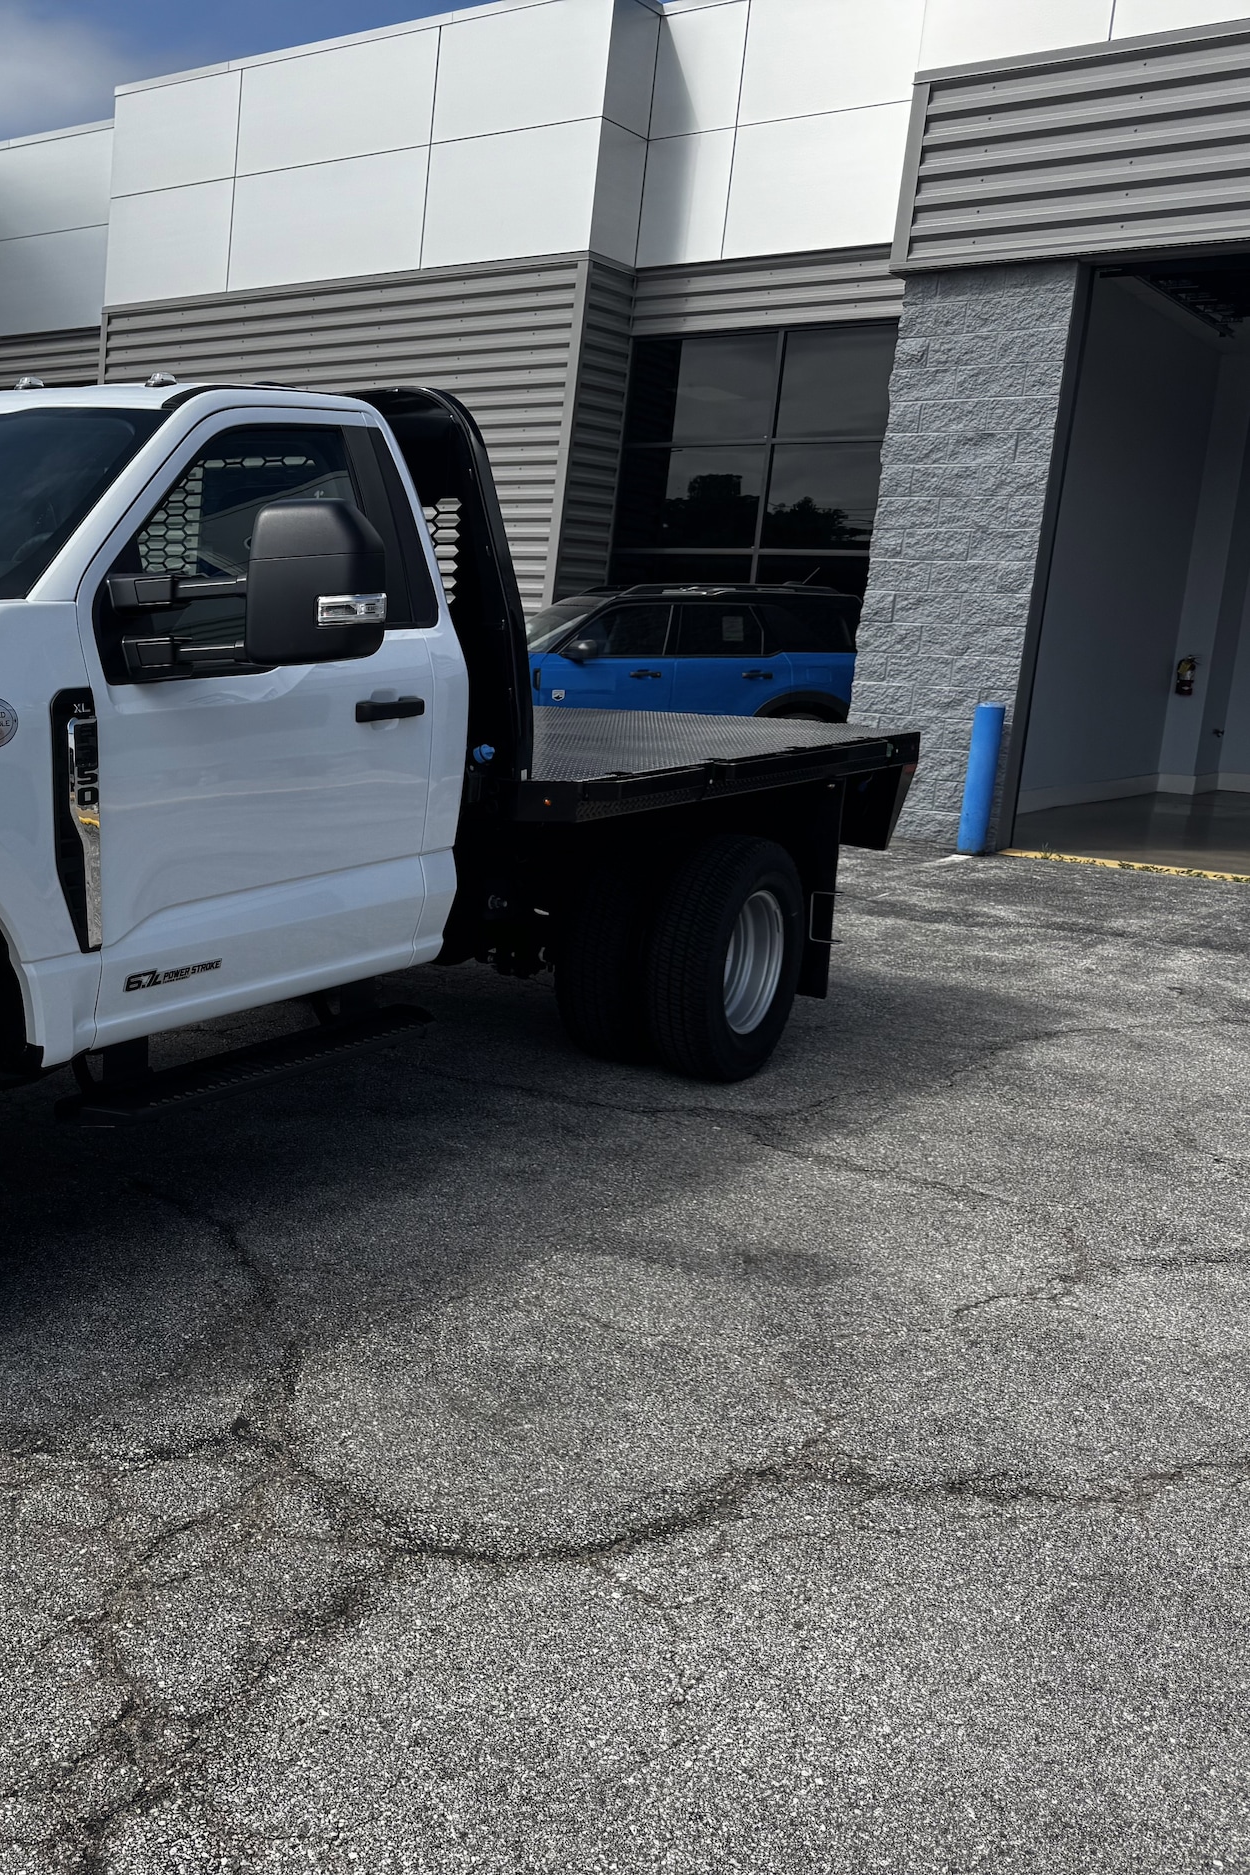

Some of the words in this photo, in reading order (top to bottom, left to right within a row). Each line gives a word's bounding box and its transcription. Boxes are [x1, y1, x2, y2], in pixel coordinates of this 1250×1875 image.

[73, 703, 91, 714] XL
[124, 969, 162, 992] 6.7L
[163, 967, 191, 980] POWER
[191, 960, 221, 975] STROKE
